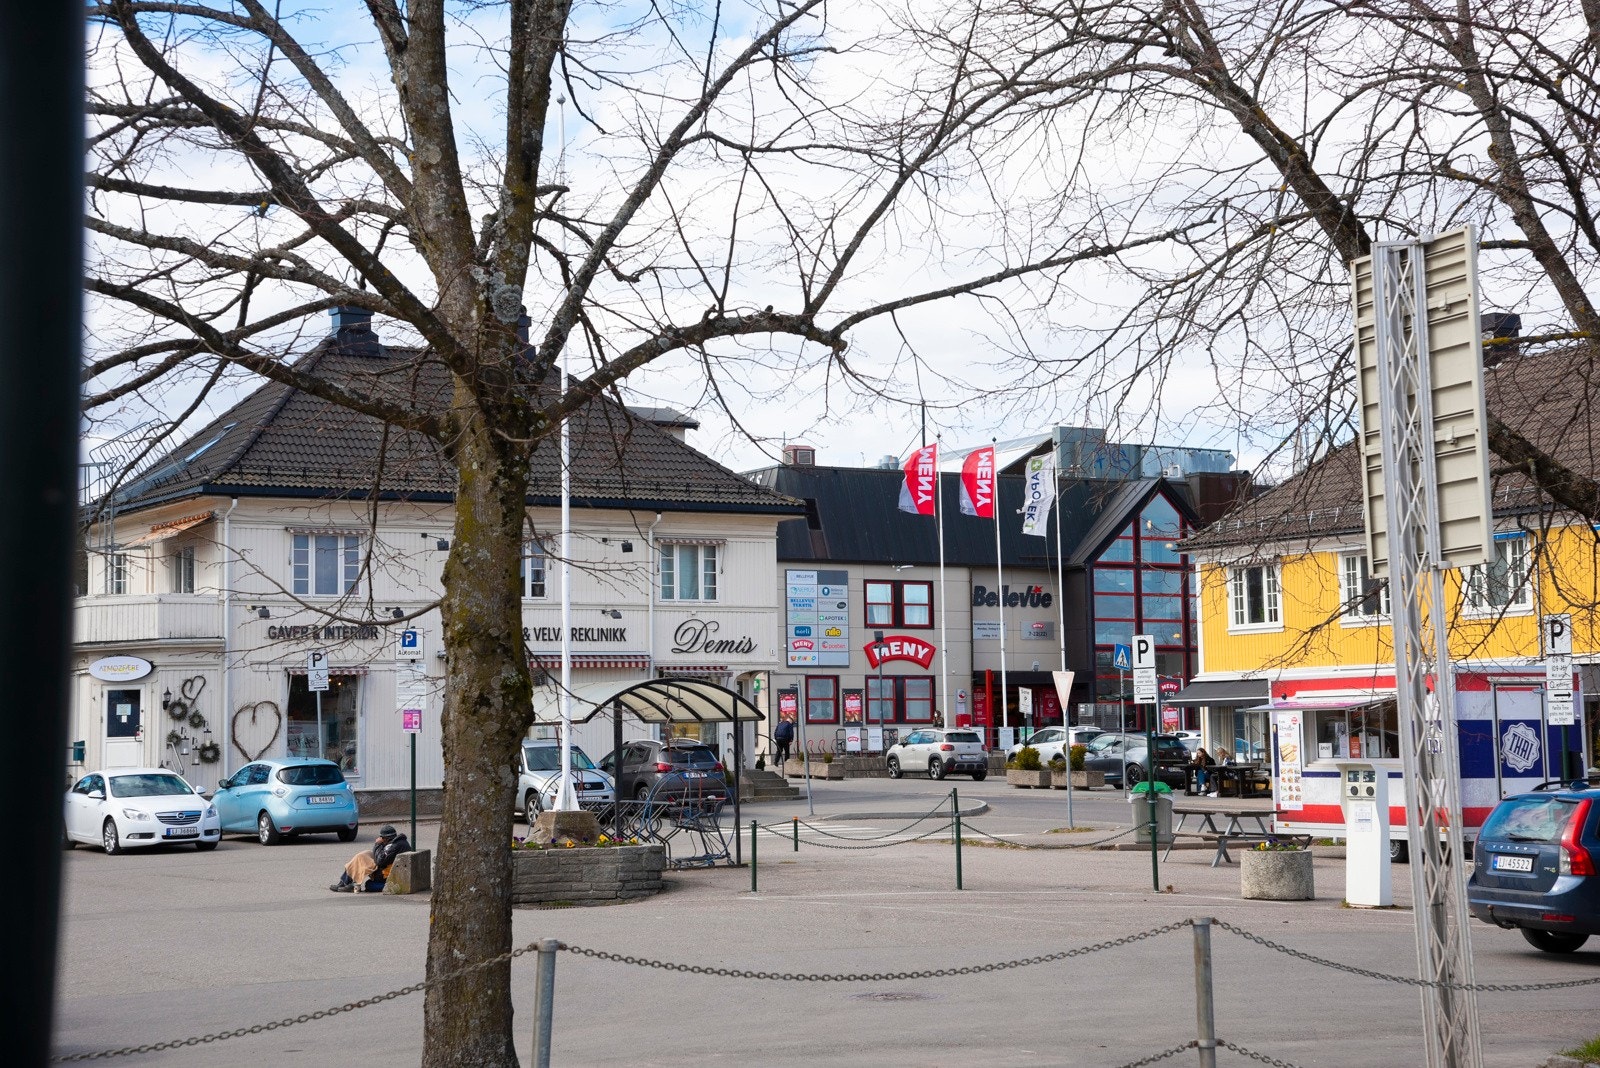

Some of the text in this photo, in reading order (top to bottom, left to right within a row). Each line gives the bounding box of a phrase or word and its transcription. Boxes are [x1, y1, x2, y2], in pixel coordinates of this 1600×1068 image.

[268, 626, 309, 640] GAVER
[534, 627, 626, 641] VELVREKLINIKK
[671, 619, 758, 654] Demis
[1551, 619, 1564, 648] P
[873, 641, 929, 659] MENY
[1137, 640, 1149, 663] P
[312, 653, 322, 667] P
[1509, 733, 1534, 760] THAI
[1508, 858, 1530, 870] 45522
